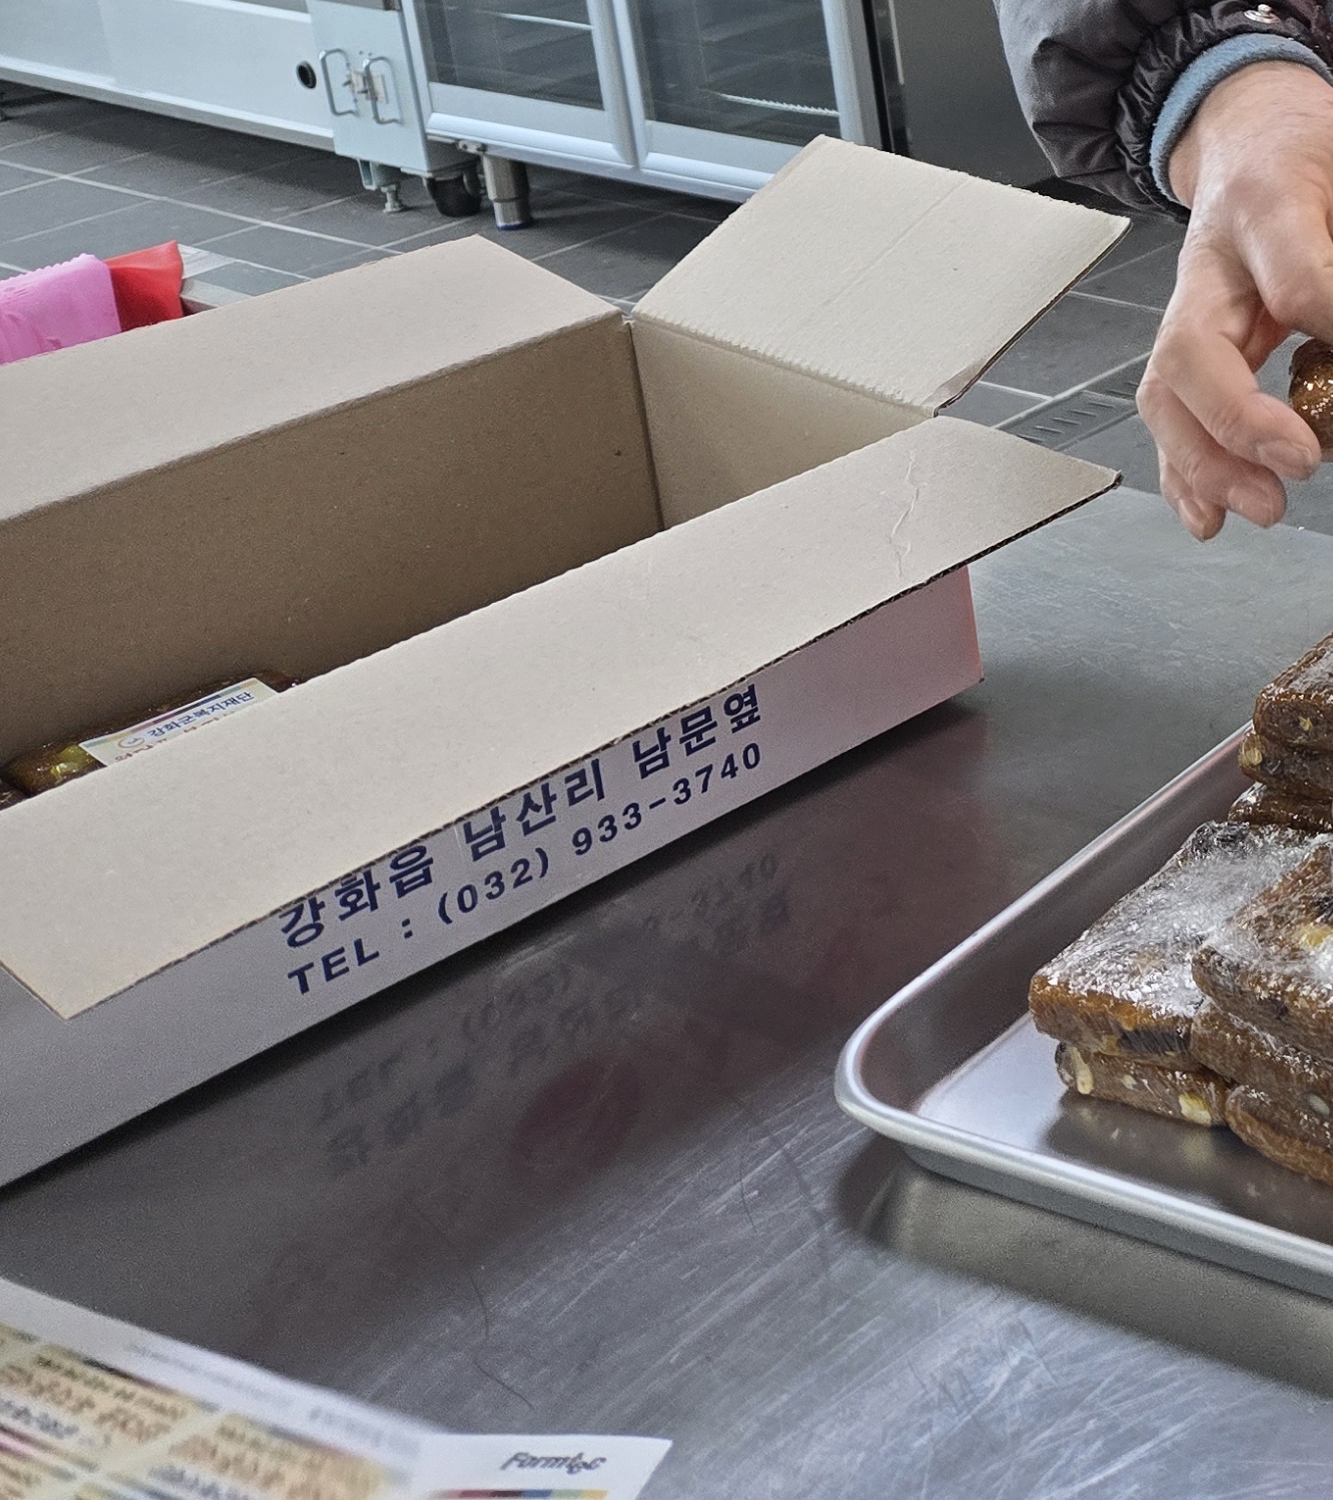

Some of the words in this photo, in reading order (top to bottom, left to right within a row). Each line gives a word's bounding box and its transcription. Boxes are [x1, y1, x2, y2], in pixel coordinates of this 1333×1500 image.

[148, 691, 254, 737] 강화군복지재단
[279, 846, 433, 948] 강화읍
[463, 758, 605, 862] 남산리
[632, 683, 761, 780] 남문옆
[287, 938, 380, 995] TEL
[438, 847, 549, 925] (032)
[571, 742, 762, 857] 933-3740
